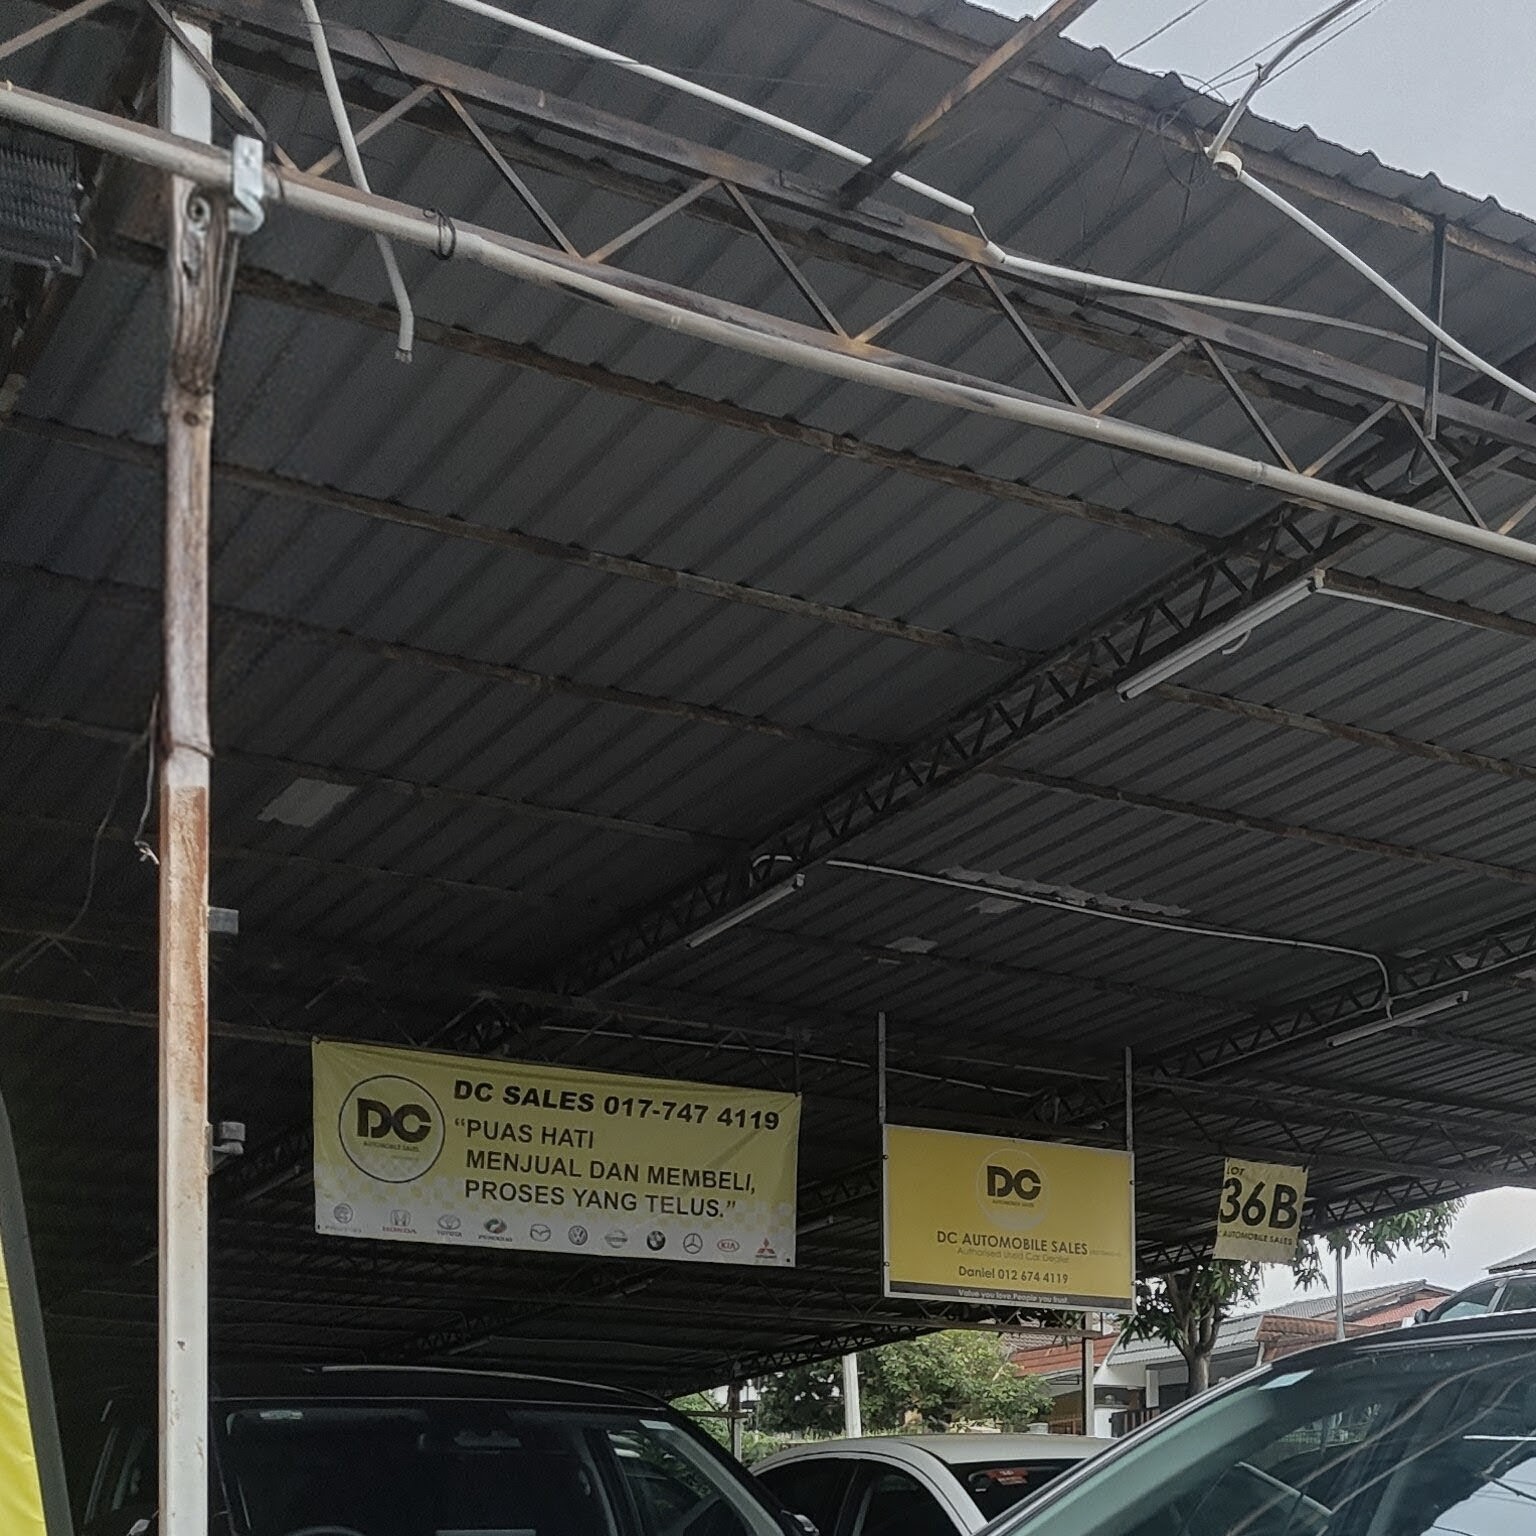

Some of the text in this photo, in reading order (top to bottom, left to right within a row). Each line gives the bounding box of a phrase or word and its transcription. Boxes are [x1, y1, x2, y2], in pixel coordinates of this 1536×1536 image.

[357, 1098, 432, 1143] DC
[454, 1079, 780, 1131] DC SALES 017-747 4119
[541, 1126, 594, 1149] HATI
[466, 1149, 755, 1195] MENJUAL DAN MEMBELI,
[986, 1164, 1042, 1201] DC
[465, 1179, 564, 1206] PROSES
[572, 1187, 637, 1211] YANG
[1220, 1177, 1298, 1229] 36B
[937, 1230, 958, 1244] DC
[962, 1233, 1048, 1252] AUTOMOBILE
[1051, 1240, 1088, 1255] SALES
[958, 1265, 1069, 1284] Daniel 012 674 4119
